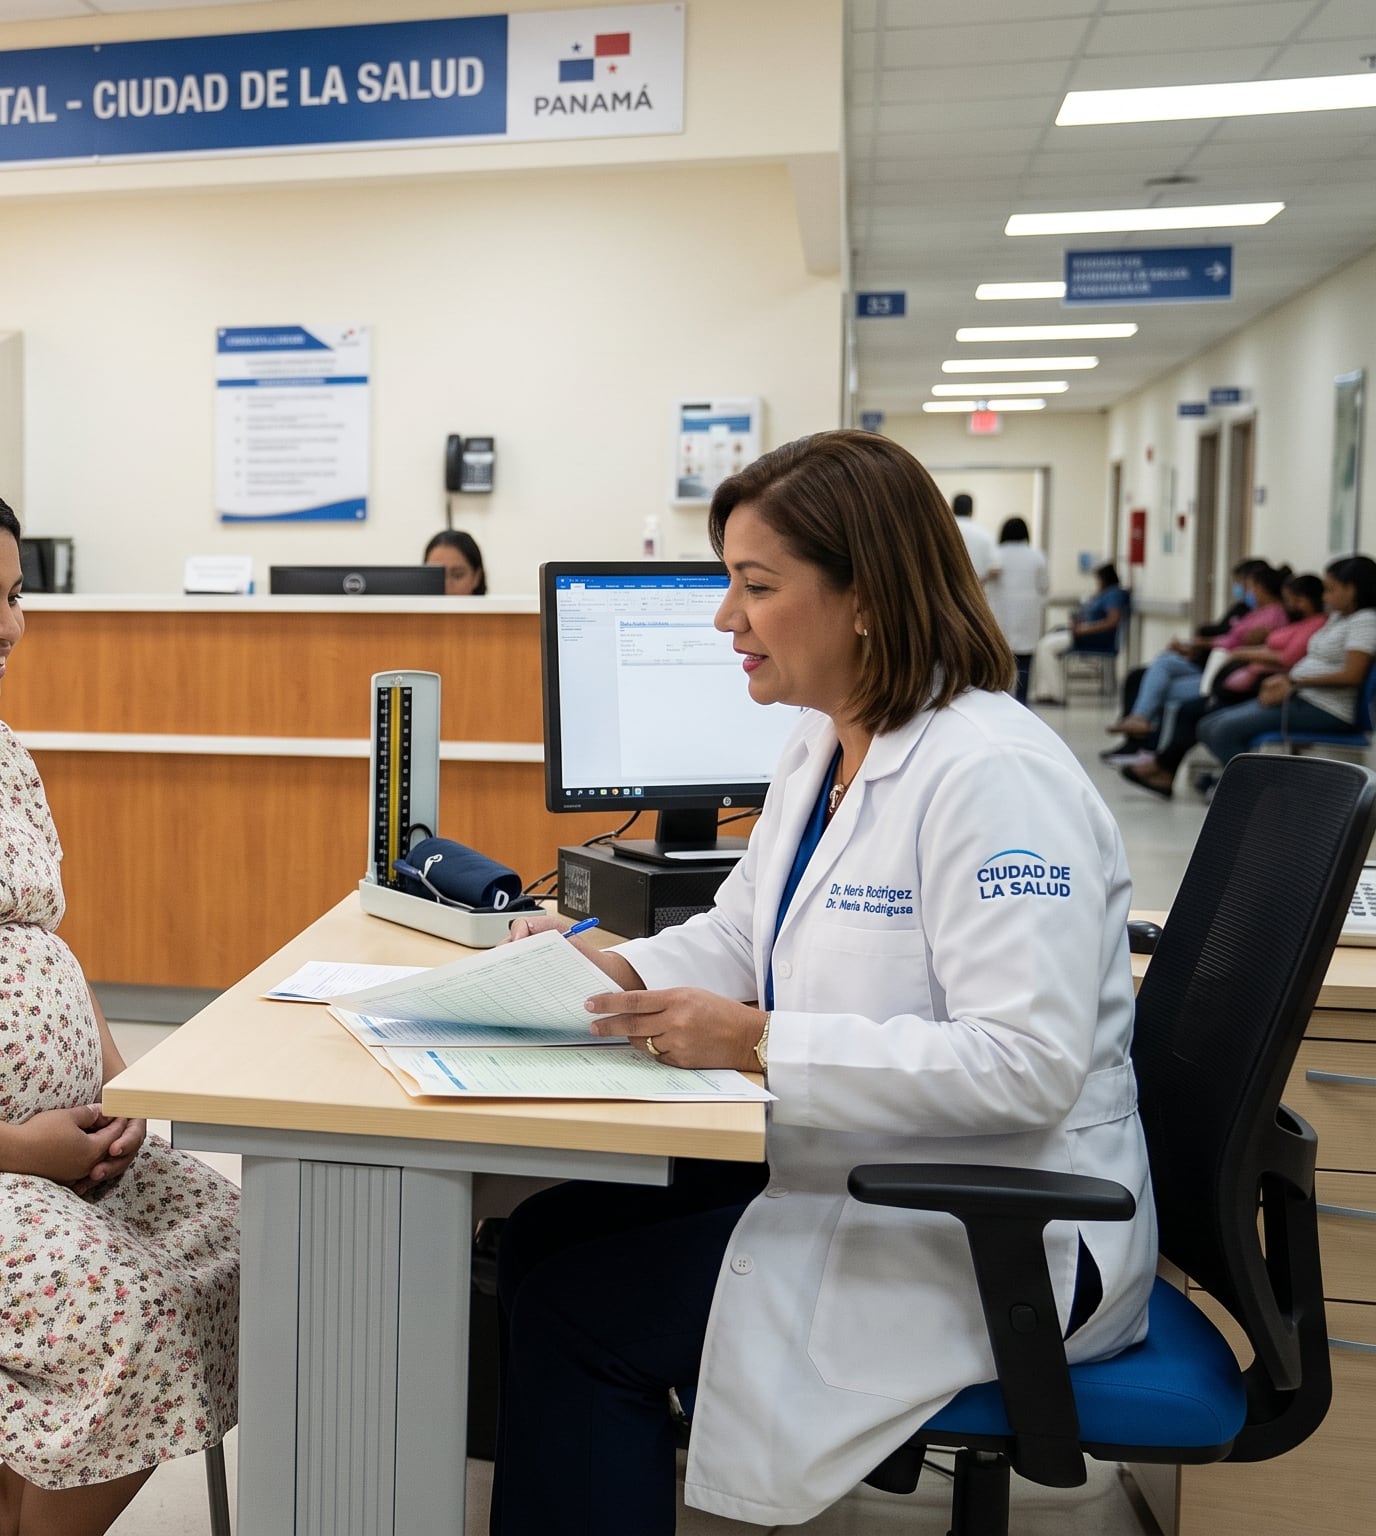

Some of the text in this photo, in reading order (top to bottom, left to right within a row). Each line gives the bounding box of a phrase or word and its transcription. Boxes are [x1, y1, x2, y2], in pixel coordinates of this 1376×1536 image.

[93, 74, 227, 120] CIUDAD
[240, 69, 288, 111] DE
[300, 64, 347, 107] LA
[357, 57, 484, 104] SALUD
[534, 83, 653, 117] PANAMÁ
[977, 864, 1071, 883] CIUDAD DE
[980, 881, 1071, 900] LA SALUD
[826, 898, 837, 909] Dr.
